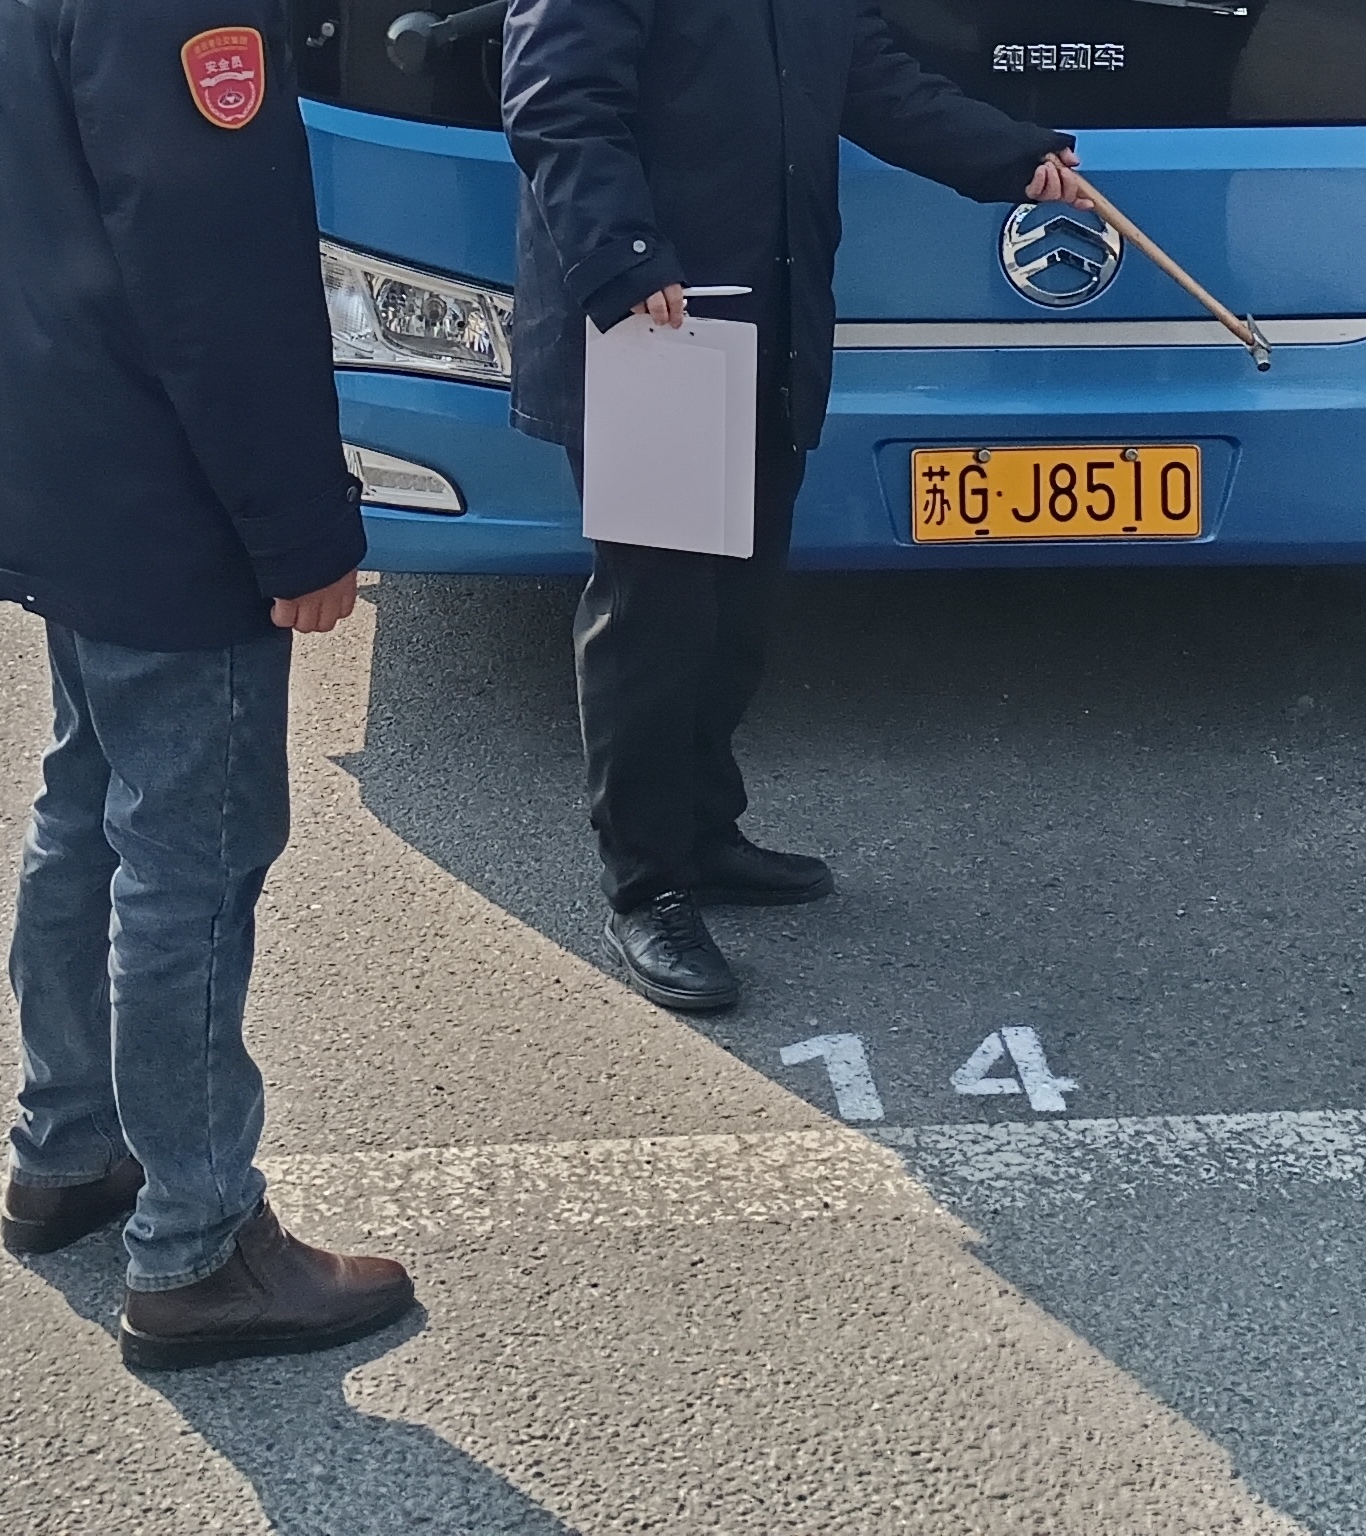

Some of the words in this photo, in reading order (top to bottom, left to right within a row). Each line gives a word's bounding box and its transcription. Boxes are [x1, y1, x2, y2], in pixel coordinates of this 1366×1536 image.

[205, 55, 243, 74] 安全员
[993, 43, 1125, 72] 纯电动车
[780, 1025, 1079, 1121] 14
